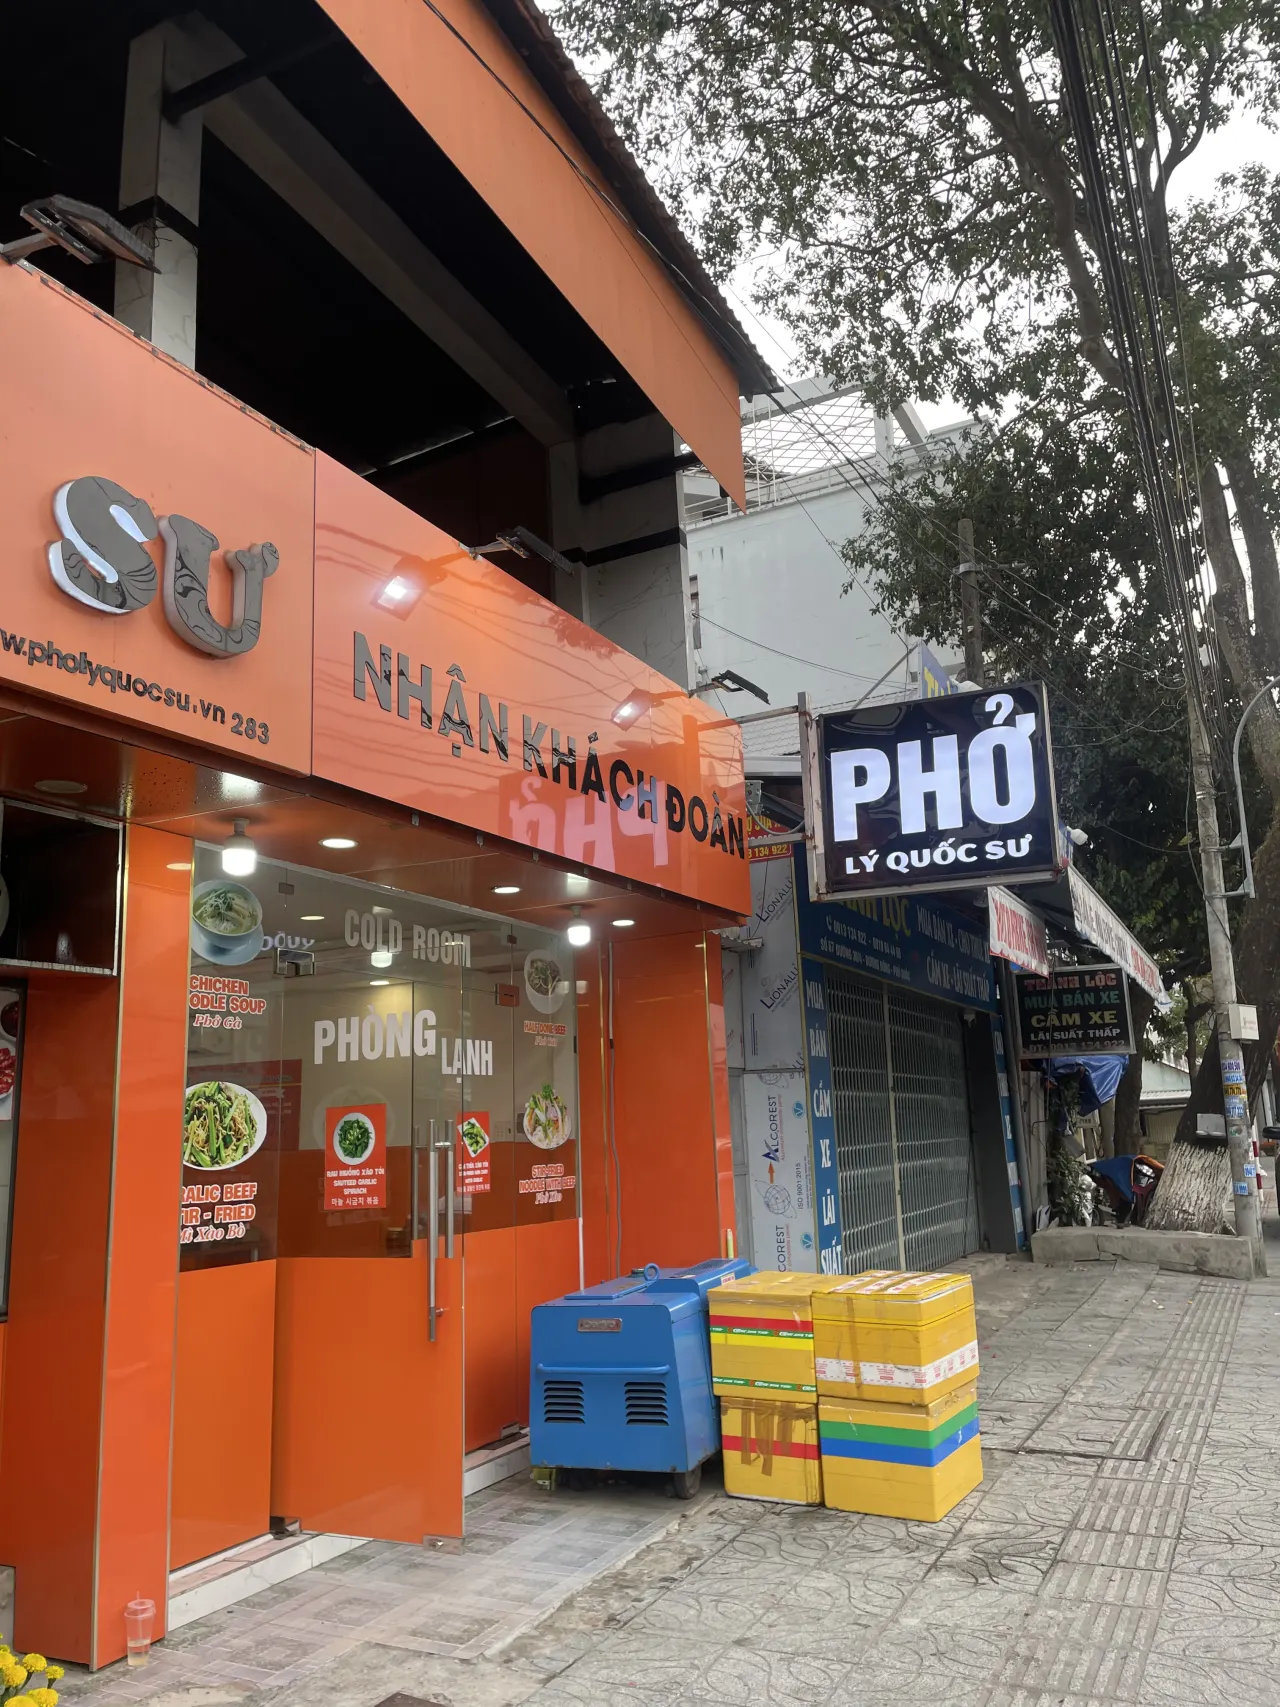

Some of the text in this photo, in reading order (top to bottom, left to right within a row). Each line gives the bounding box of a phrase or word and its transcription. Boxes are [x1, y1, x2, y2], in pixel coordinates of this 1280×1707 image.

[49, 476, 279, 660] SƯ
[231, 713, 270, 745] 283
[353, 631, 746, 860] NHẬN KHÁCH ĐOÀN
[830, 693, 1036, 842] PHỞ
[755, 846, 769, 857] 134
[772, 844, 788, 855] 922
[845, 849, 880, 875] LÝ
[886, 838, 978, 874] QUỐC
[985, 833, 1033, 860] SƯ
[344, 909, 471, 968] COLD ROOM
[190, 974, 250, 997] CHICKEN
[1085, 971, 1117, 990] LỘC
[229, 996, 267, 1015] SOUP
[1024, 990, 1120, 1010] MUA BÁN XE
[193, 1014, 243, 1030] Phở Gà
[1088, 1010, 1118, 1025] XE
[1053, 1027, 1084, 1040] SUẤT
[1087, 1025, 1121, 1038] THẤP
[314, 1005, 493, 1084] PHÒNG LẠNH
[762, 1094, 780, 1163] ALCOREST
[820, 1139, 832, 1169] XE
[222, 1182, 258, 1202] BEEF
[519, 1179, 546, 1194] NOODLE
[214, 1203, 256, 1224] FRIED
[194, 1225, 225, 1243] Xào
[226, 1221, 246, 1240] Bò
